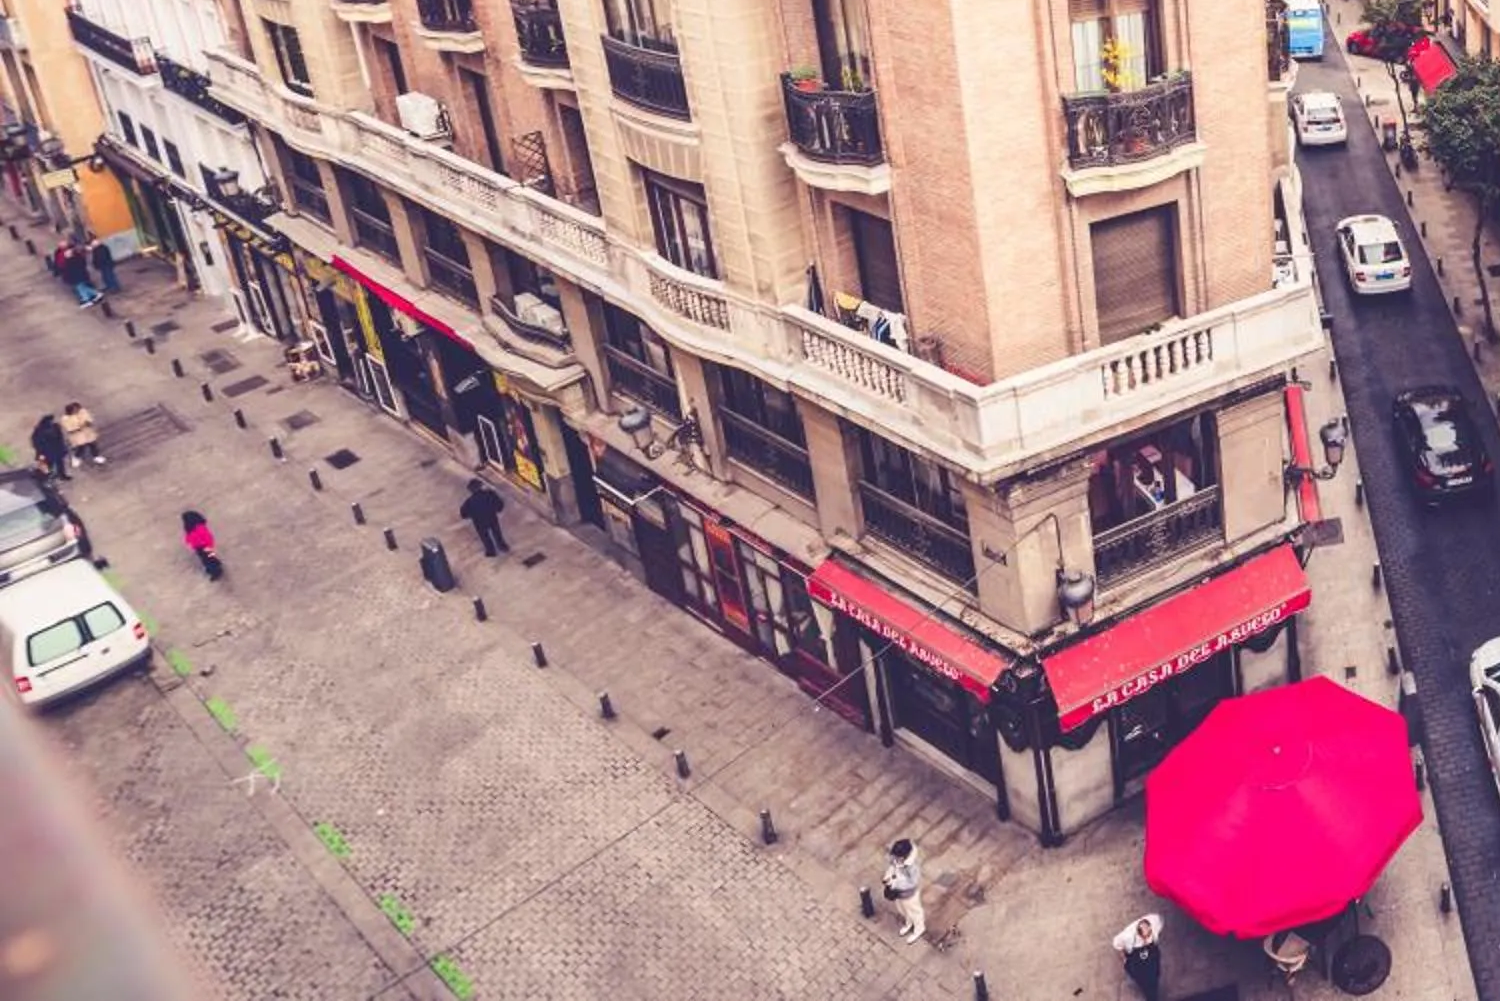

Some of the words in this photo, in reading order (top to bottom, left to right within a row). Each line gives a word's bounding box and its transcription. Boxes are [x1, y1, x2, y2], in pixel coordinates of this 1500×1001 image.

[1091, 693, 1119, 714] LA
[1121, 664, 1172, 698] CASA
[1176, 642, 1213, 669] DEL
